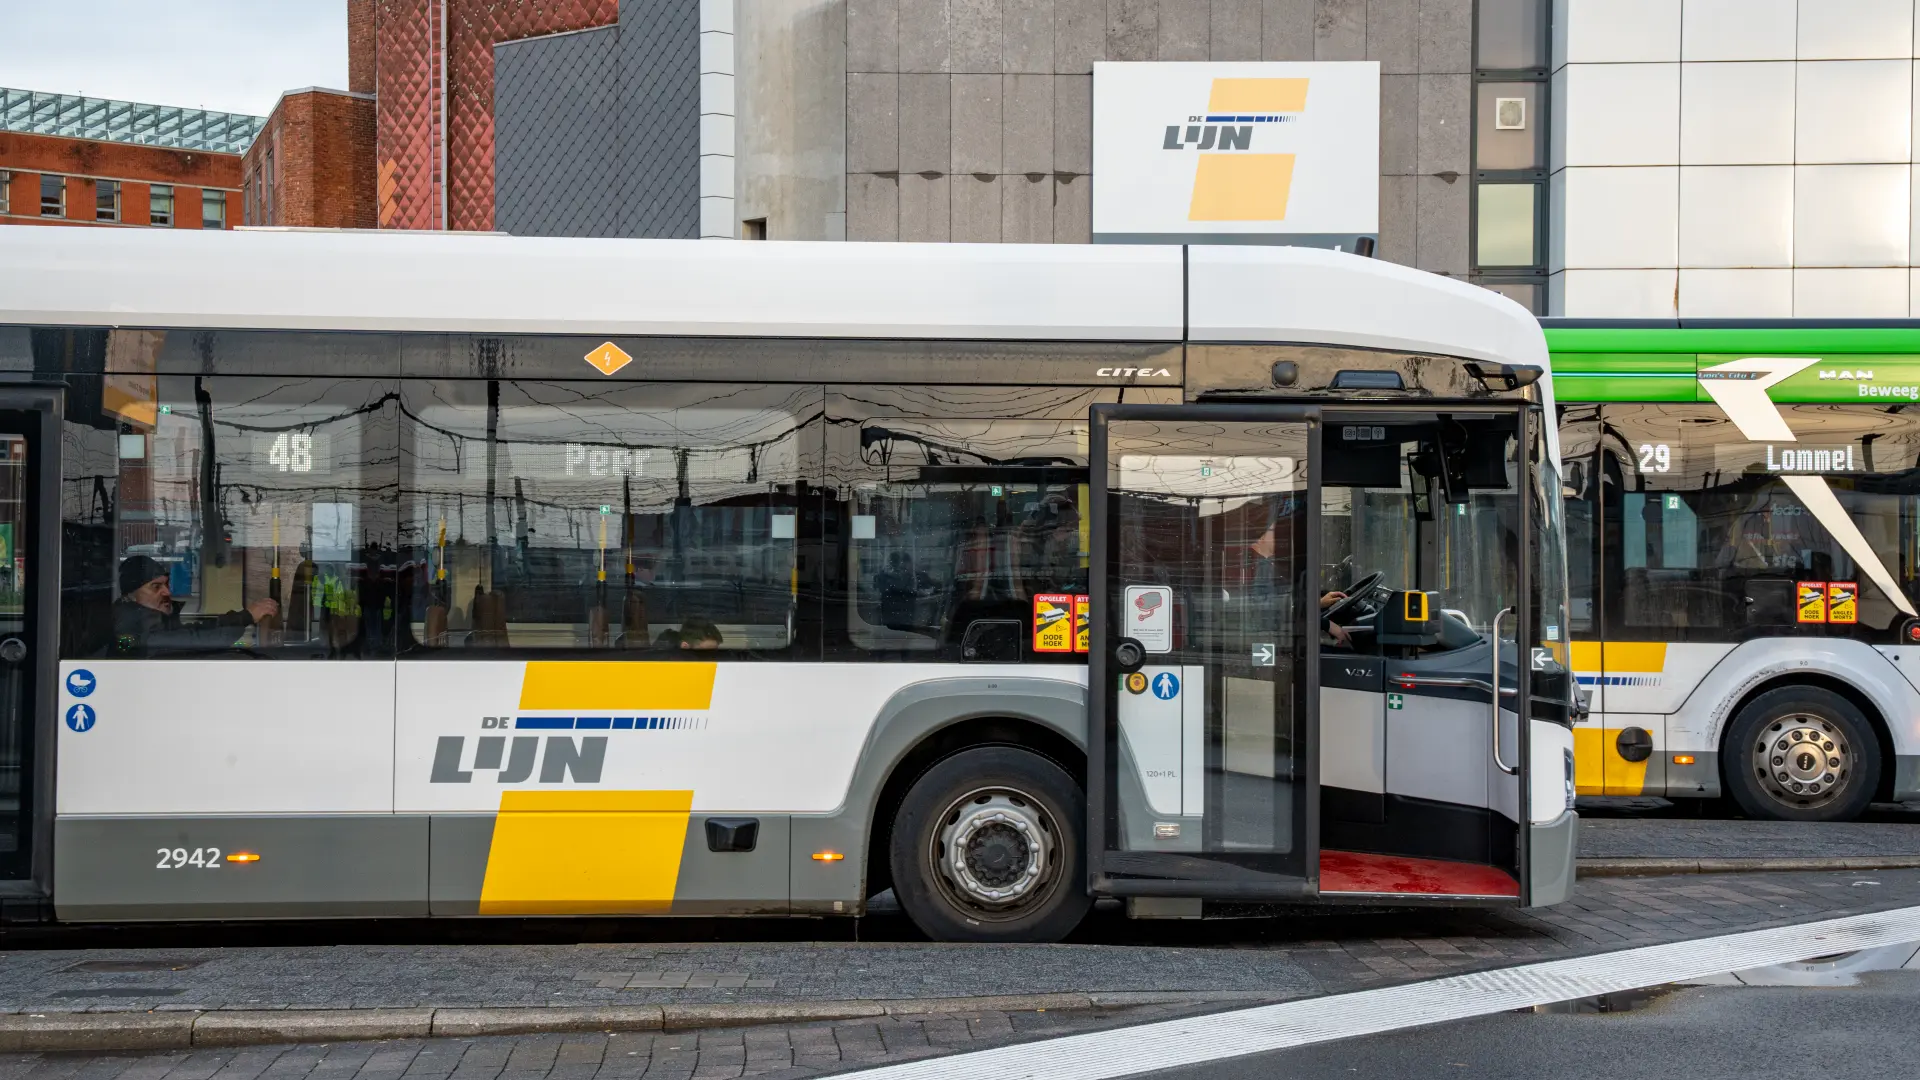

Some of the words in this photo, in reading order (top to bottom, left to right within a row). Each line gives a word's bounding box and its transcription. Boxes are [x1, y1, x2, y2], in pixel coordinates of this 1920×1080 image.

[1162, 125, 1253, 150] LIJN
[1096, 367, 1171, 377] CITEA
[1819, 370, 1873, 380] MAN
[1858, 384, 1919, 400] Beweeg
[270, 434, 311, 472] 48
[566, 443, 650, 476] Peer
[1639, 444, 1671, 473] 29
[1766, 444, 1854, 472] Lommel
[481, 716, 510, 729] DE
[429, 736, 609, 783] LIJN
[1146, 770, 1166, 778] 120+1
[156, 847, 221, 869] 2942
